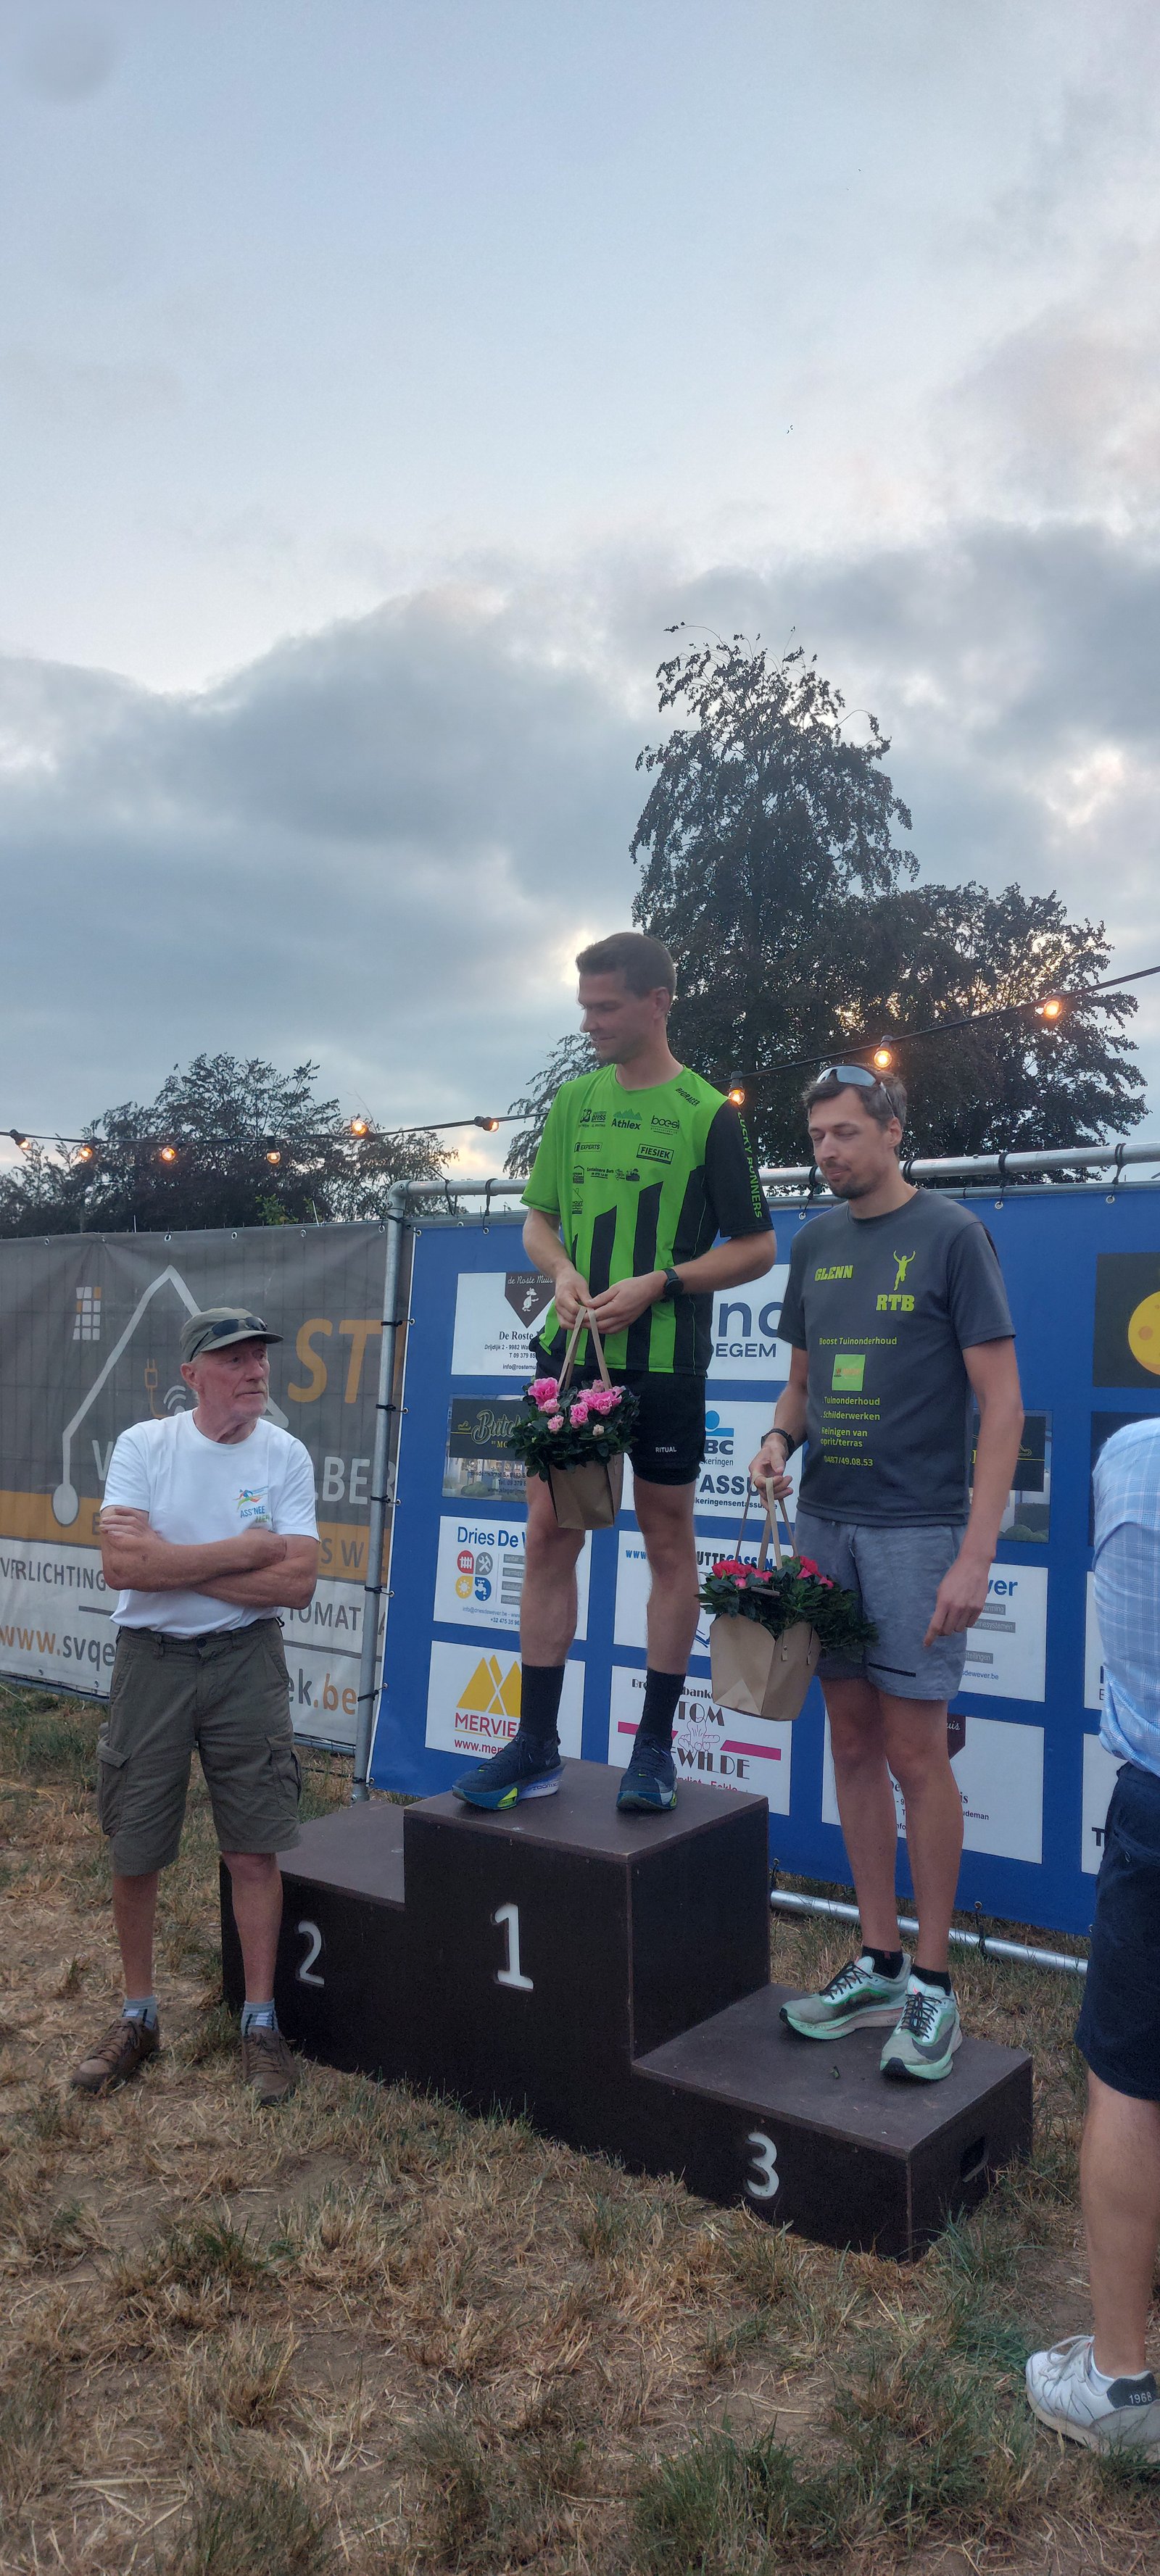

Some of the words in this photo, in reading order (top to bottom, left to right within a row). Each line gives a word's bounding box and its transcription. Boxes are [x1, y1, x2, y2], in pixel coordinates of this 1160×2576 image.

[611, 1118, 642, 1130] Athlex
[641, 1147, 671, 1159] FIESIEK
[737, 1112, 753, 1153] LUCKY
[747, 1157, 763, 1218] RUNNERS
[815, 1266, 853, 1281] GLENN
[876, 1294, 915, 1312] RTB
[500, 1331, 509, 1340] De
[512, 1331, 533, 1340] Roste
[716, 1343, 776, 1358] EGEM
[704, 1439, 734, 1455] BC
[821, 1438, 863, 1447] oprit/terras
[824, 1455, 873, 1466] 0487/49.08.53
[699, 1474, 761, 1496] ASSU
[457, 1526, 494, 1545] Dries
[498, 1529, 518, 1547] De
[678, 1701, 725, 1727] TOM
[455, 1713, 521, 1737] MERVIE
[297, 1920, 324, 1987] 2
[494, 1902, 534, 1990] 1
[745, 2132, 779, 2197] 3
[1129, 2392, 1152, 2404] 1968
